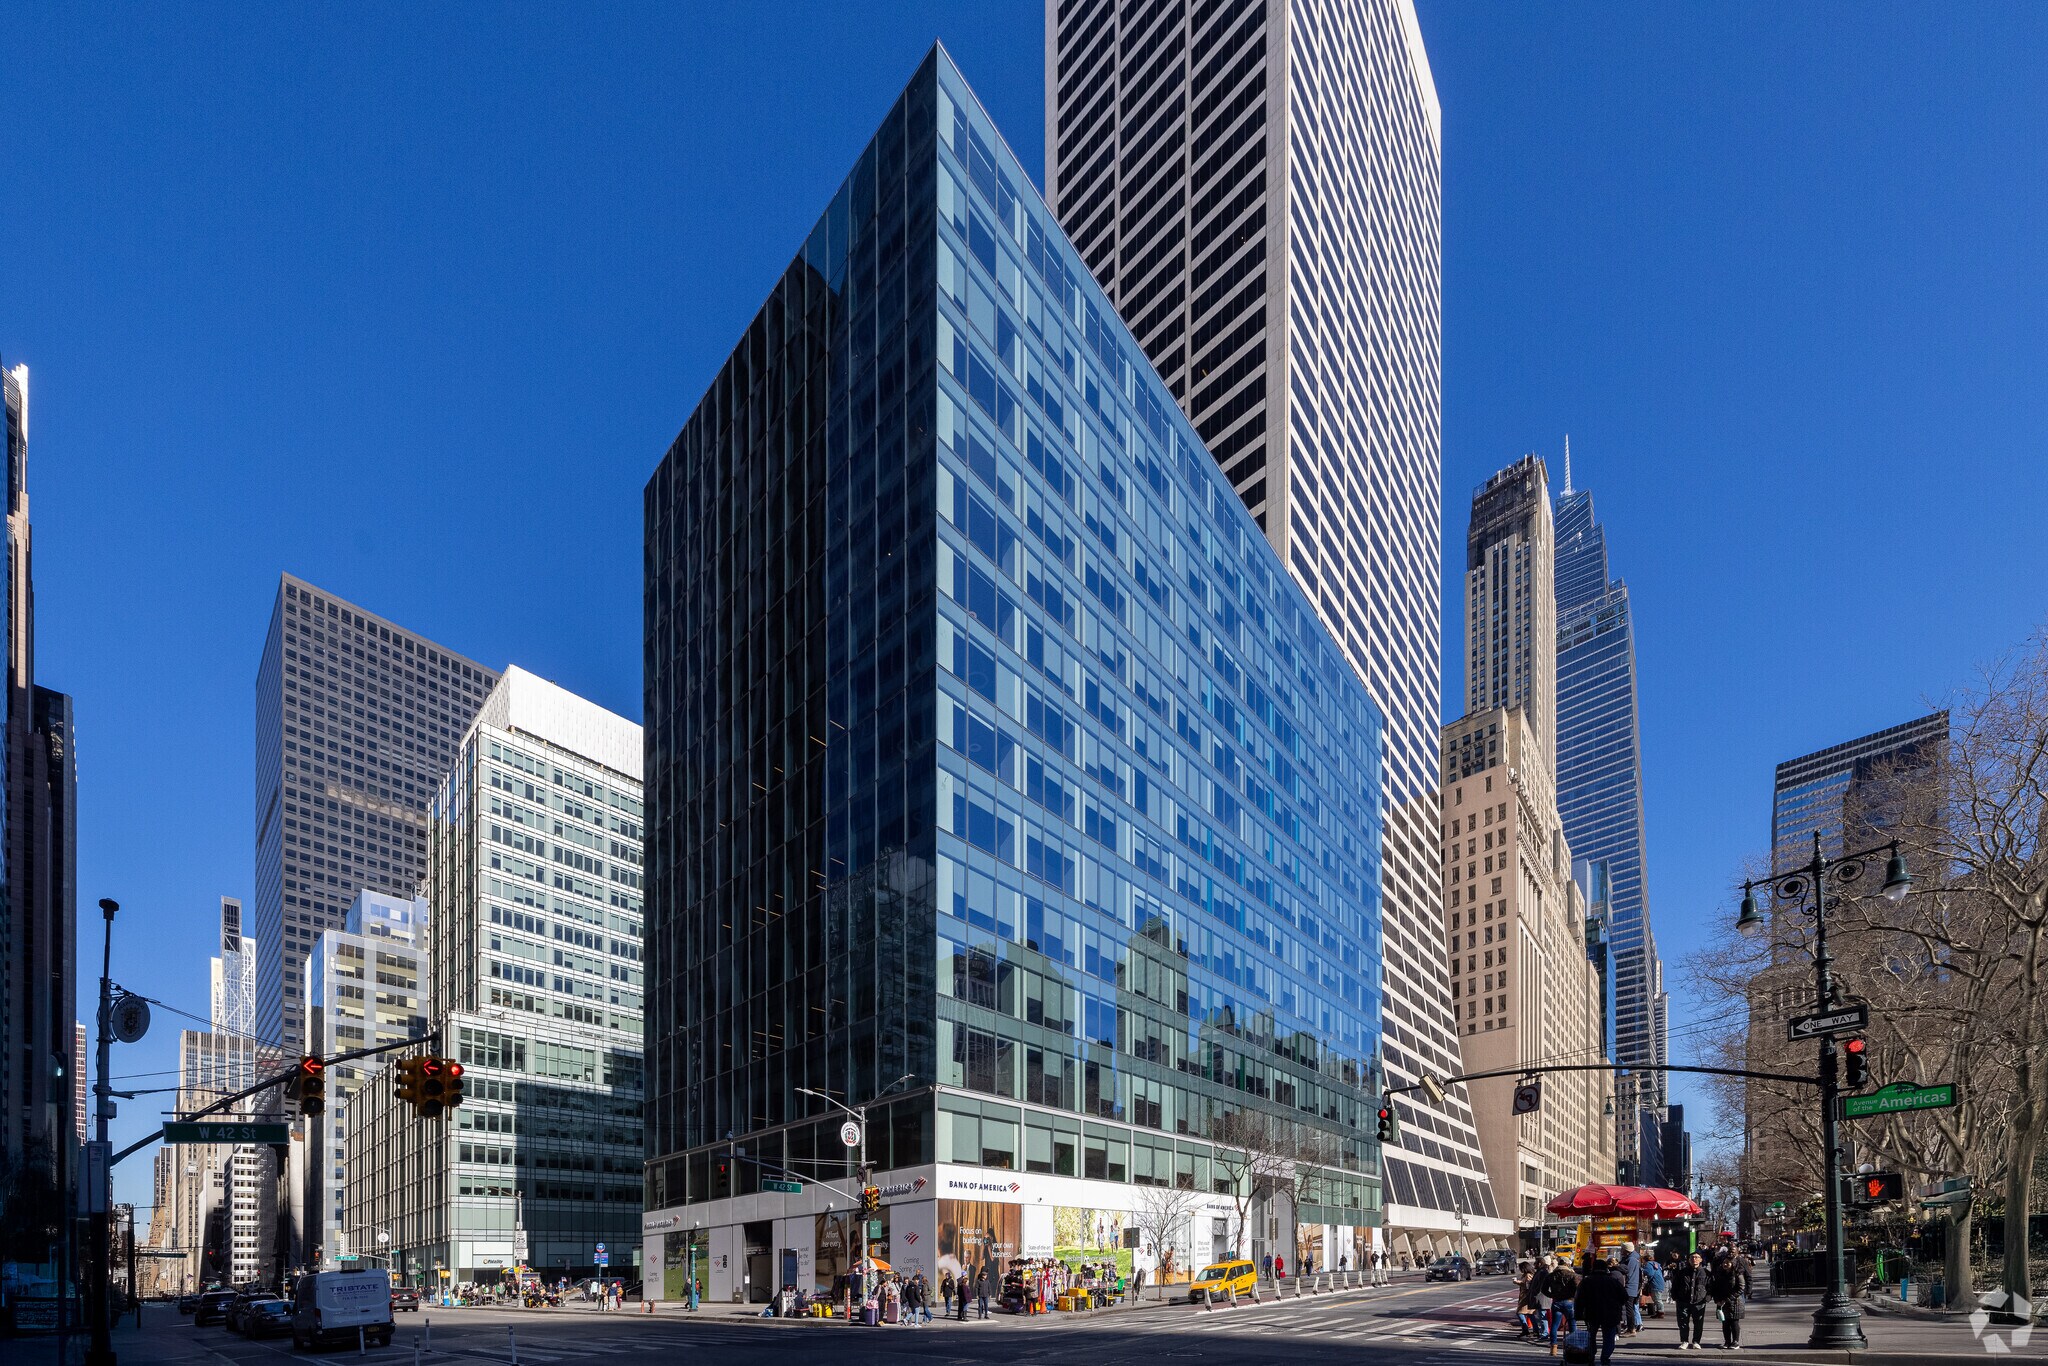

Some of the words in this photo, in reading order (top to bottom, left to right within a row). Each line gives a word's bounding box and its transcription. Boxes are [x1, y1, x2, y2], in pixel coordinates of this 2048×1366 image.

[1803, 1020, 1822, 1030] ONE
[1831, 1014, 1853, 1024] WAY
[1879, 1092, 1947, 1109] Americas
[198, 1126, 210, 1139] W
[216, 1126, 236, 1139] 42
[241, 1126, 257, 1139] St
[949, 1180, 968, 1189] BANK
[969, 1182, 978, 1190] OF
[979, 1183, 1007, 1192] AMERICA
[825, 1230, 839, 1238] Afford
[960, 1226, 975, 1234] Focus
[962, 1236, 982, 1246] building
[903, 1256, 920, 1265] Coming
[899, 1265, 912, 1273] Spring
[329, 1283, 379, 1293] TRISTATE
